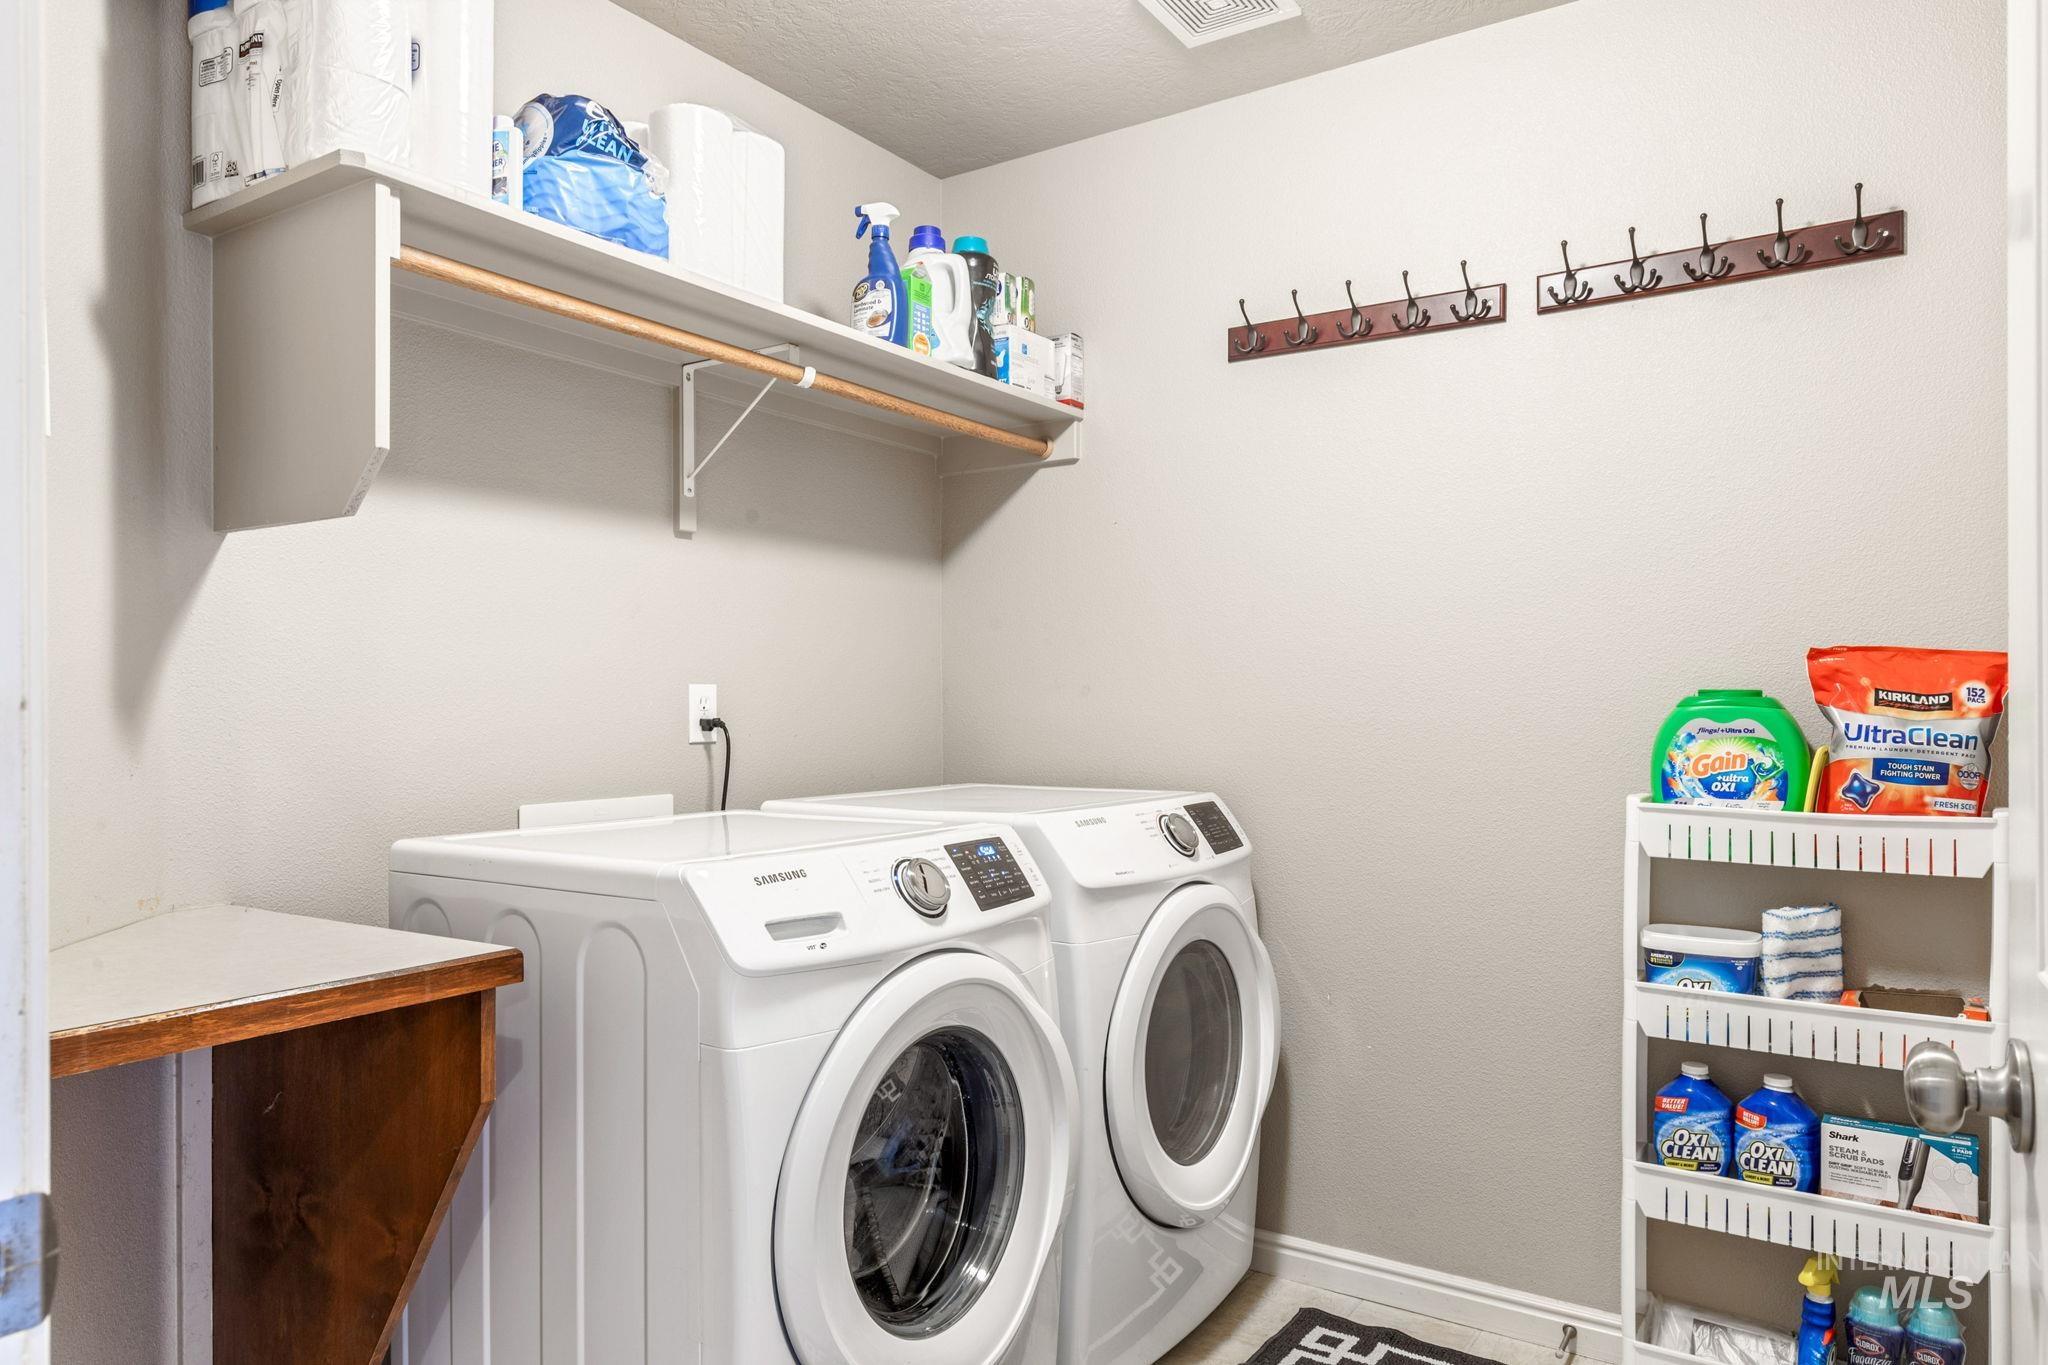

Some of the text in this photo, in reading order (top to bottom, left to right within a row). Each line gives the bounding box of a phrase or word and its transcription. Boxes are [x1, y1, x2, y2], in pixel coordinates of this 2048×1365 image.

[1878, 690, 1950, 705] KIRKLAND
[1966, 687, 1986, 698] 152
[1967, 696, 1986, 704] PACS
[1844, 722, 1979, 751] UltraClean
[1879, 746, 1914, 754] LAUNDRY
[1916, 749, 1959, 757] DETERGENT
[1692, 751, 1747, 777] Gain
[1887, 762, 1935, 772] TOUGH STAIN
[1880, 769, 1941, 780] FIGHTING POWER
[1933, 800, 1959, 810] FRESH
[1074, 816, 1107, 828] SAMSUNG
[753, 868, 808, 887] SAMSUNG
[1662, 1097, 1686, 1105] BETTER
[1673, 1128, 1709, 1147] OXI
[1828, 1130, 1859, 1142] Shark
[1661, 1140, 1719, 1162] CLEAN
[1750, 1140, 1784, 1161] OXI
[1828, 1145, 1859, 1156] STEAM
[1739, 1152, 1794, 1177] CLEAN
[1828, 1151, 1885, 1166] SCRUB PADS
[1855, 1337, 1880, 1353] CLOROX
[1916, 1351, 1941, 1365] CLOROX
